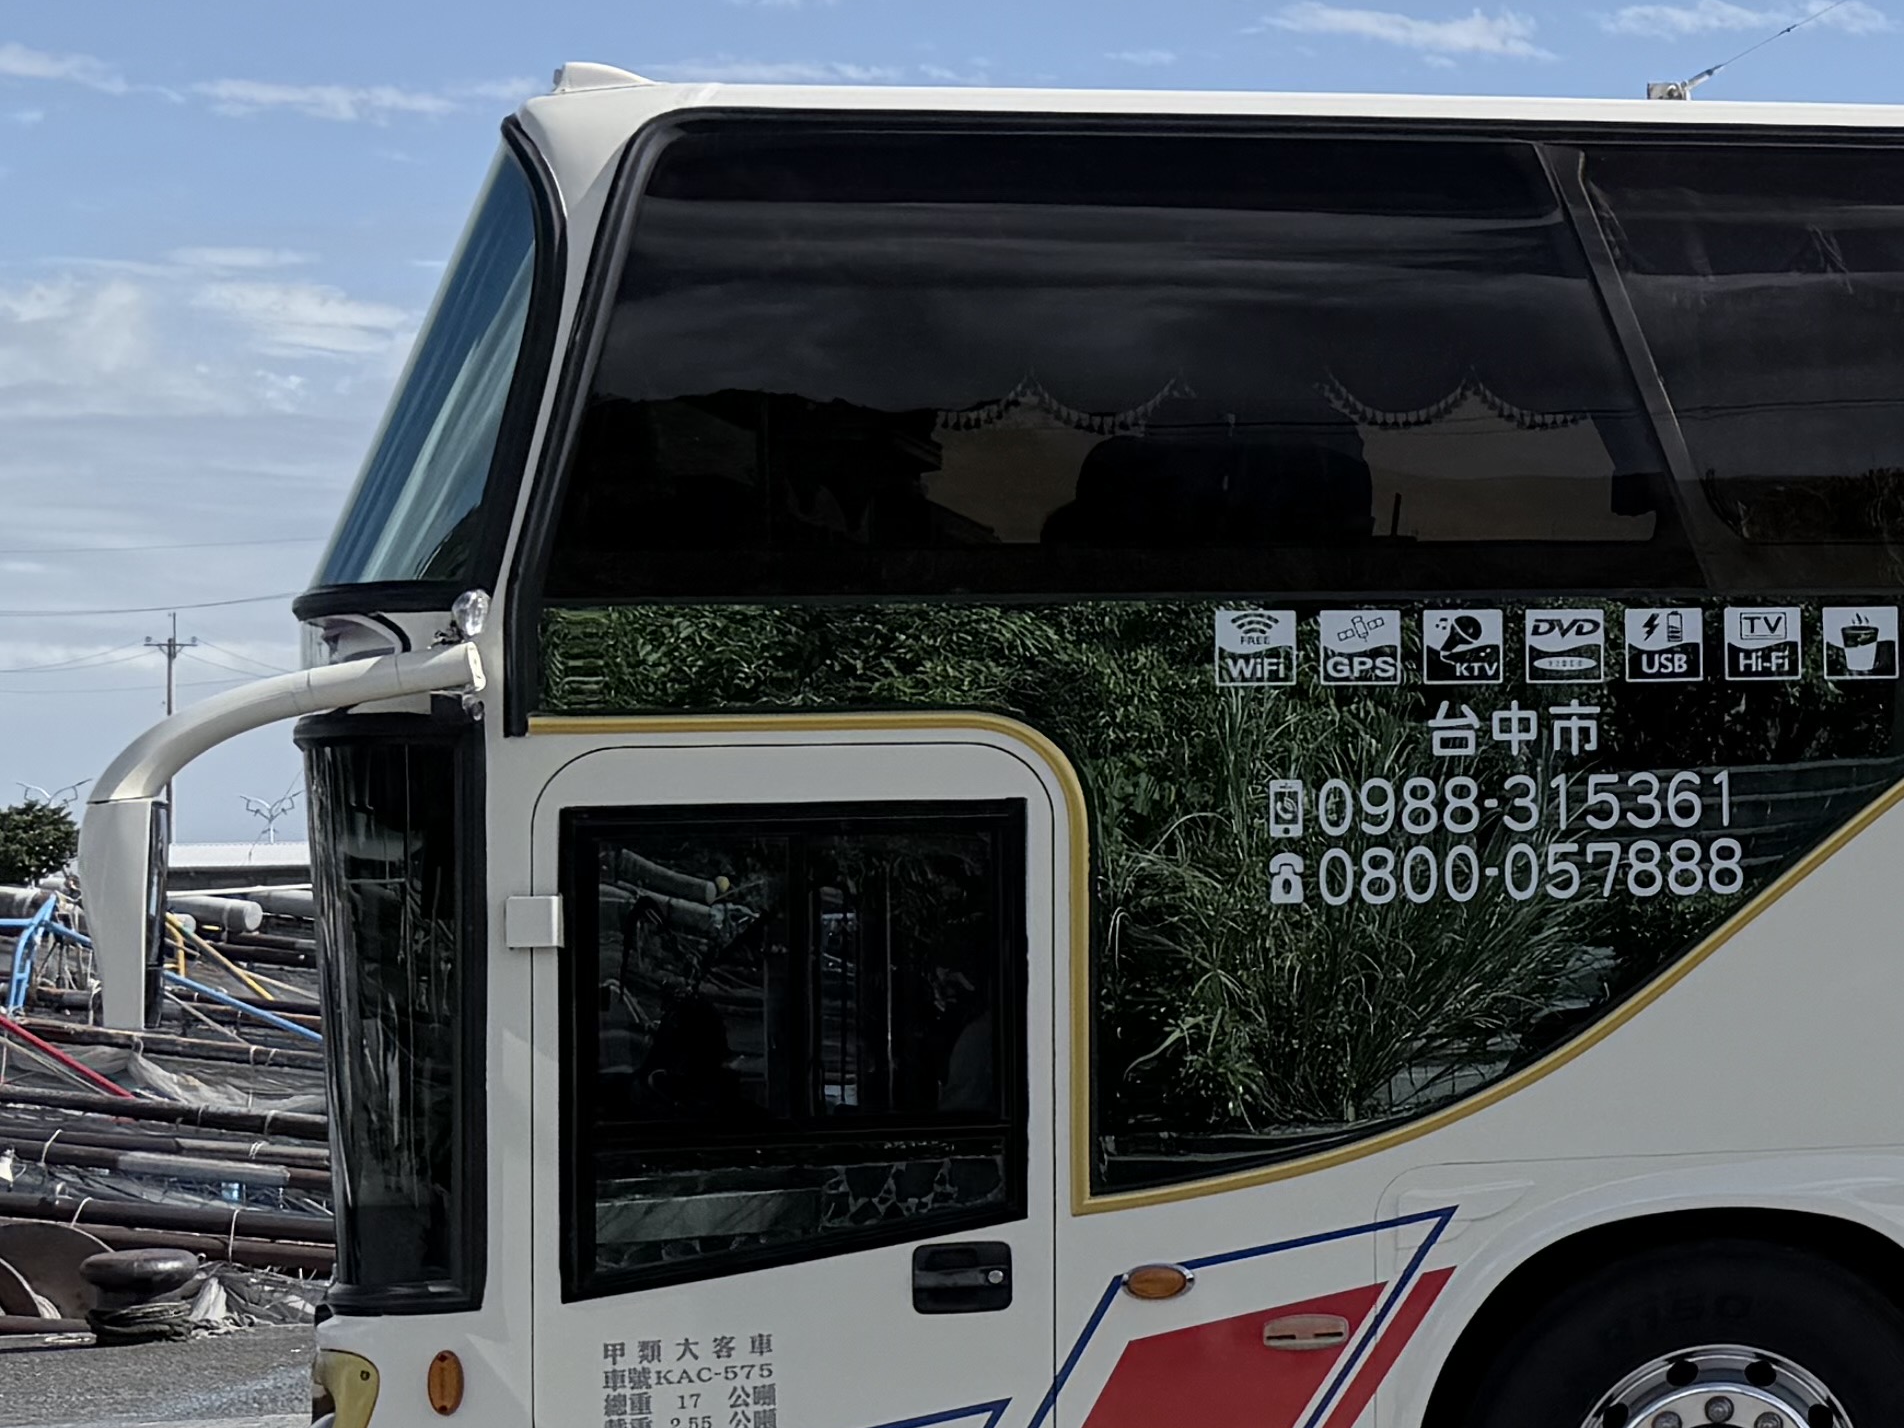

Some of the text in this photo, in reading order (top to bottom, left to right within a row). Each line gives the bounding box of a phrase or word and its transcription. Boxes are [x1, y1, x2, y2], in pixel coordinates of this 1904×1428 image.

[1531, 619, 1601, 639] DVD
[1742, 616, 1780, 634] TV
[1240, 635, 1270, 645] FREE
[1227, 657, 1286, 680] WiFi
[1326, 657, 1396, 678] GPS
[1455, 662, 1498, 677] KTV
[1641, 653, 1687, 674] USB
[1739, 652, 1790, 672] Hi-Fi
[1428, 699, 1601, 758] 台中市
[1317, 770, 1734, 837] 0988-315361
[1318, 838, 1744, 906] 0800-057888
[603, 1333, 773, 1366] 甲類大客車
[603, 1383, 776, 1417] 總重 17 公噸
